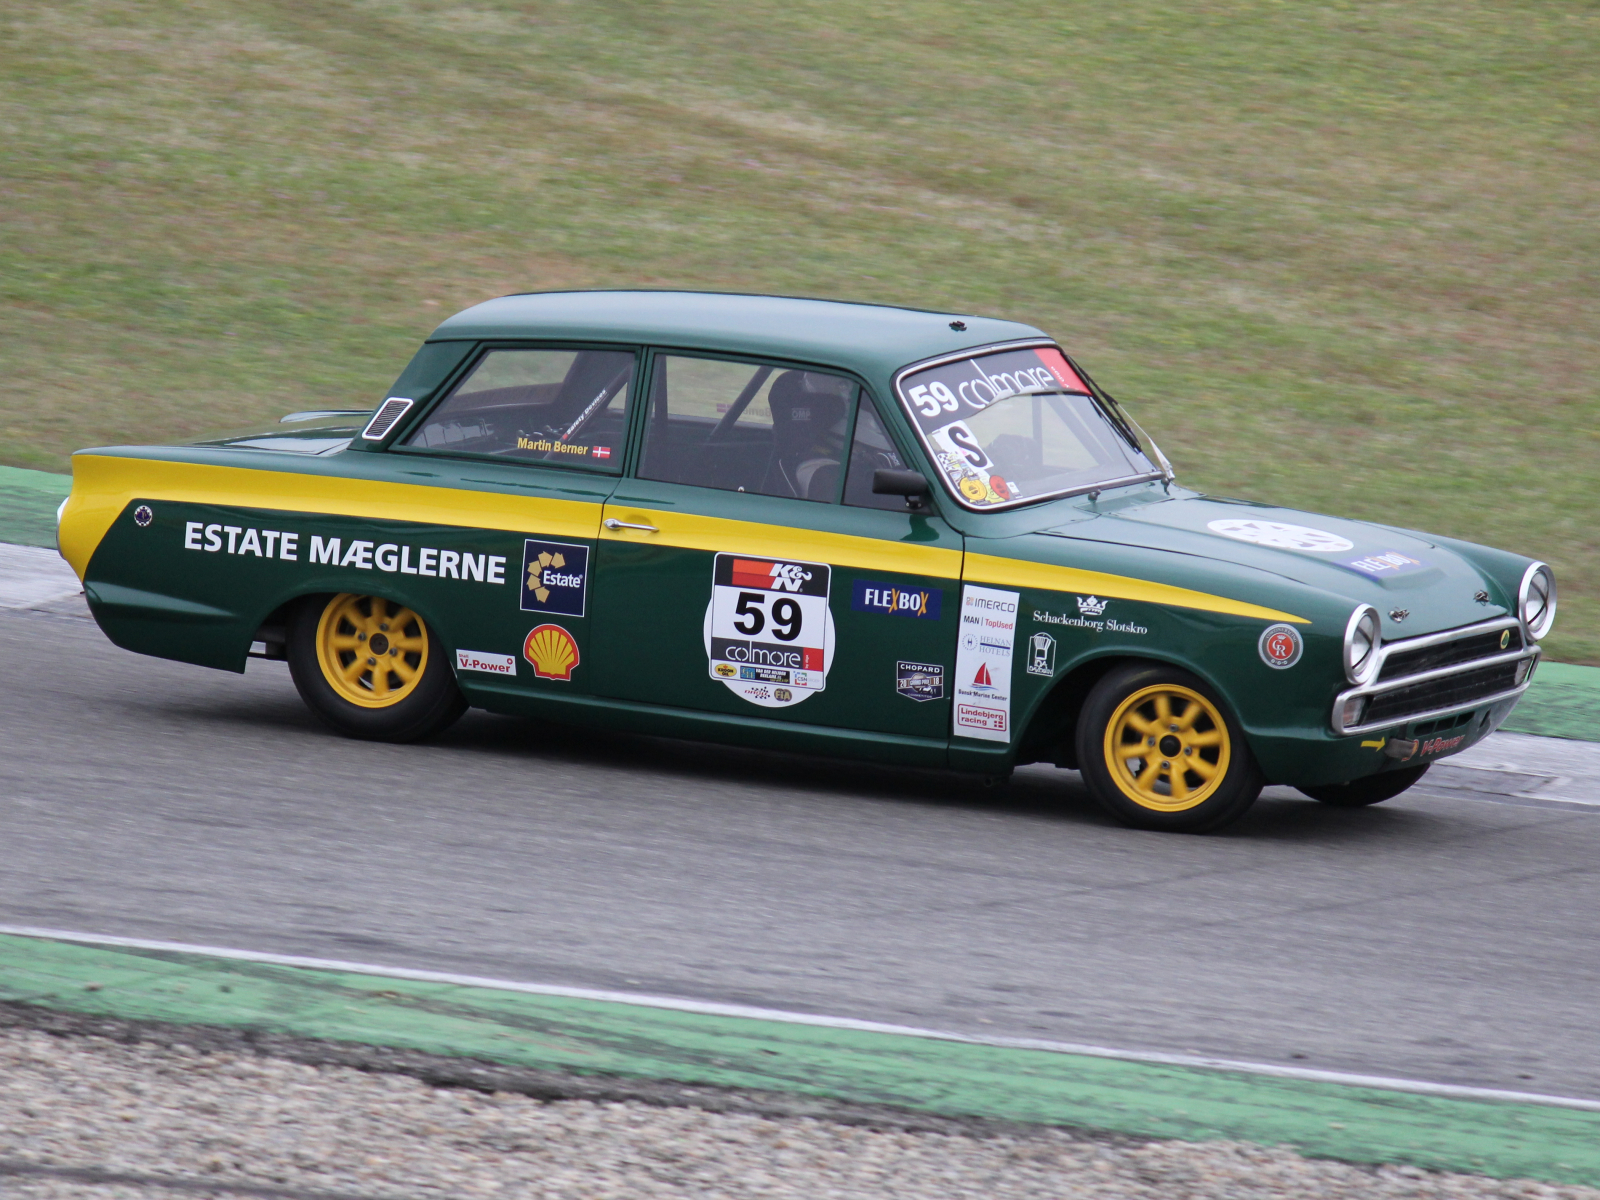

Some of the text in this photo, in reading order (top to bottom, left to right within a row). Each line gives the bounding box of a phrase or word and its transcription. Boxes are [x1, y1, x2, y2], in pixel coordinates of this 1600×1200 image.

[909, 359, 1055, 417] 59 colmore
[566, 413, 585, 435] Safety
[517, 437, 589, 455] Martin Berner
[947, 425, 988, 468] S
[184, 521, 506, 585] ESTATE MÆGLERNE
[542, 569, 582, 588] Estate
[864, 587, 930, 617] FLEXBOX
[974, 597, 1016, 613] IMERCO
[733, 591, 803, 642] 59
[963, 614, 1014, 631] MAN TopUsed
[1032, 609, 1148, 635] Schackenborg Slotskro
[979, 635, 1012, 647] HELNAN
[725, 641, 802, 669] colmore
[979, 646, 1012, 658] HOTELS
[460, 658, 511, 673] V-Power
[900, 663, 941, 674] CHOPARD
[933, 677, 940, 685] 18
[958, 688, 1008, 702] Dansk Marine Center
[960, 707, 1004, 721] Lindebjerg
[961, 715, 988, 726] racing
[1419, 734, 1466, 757] V-Power
